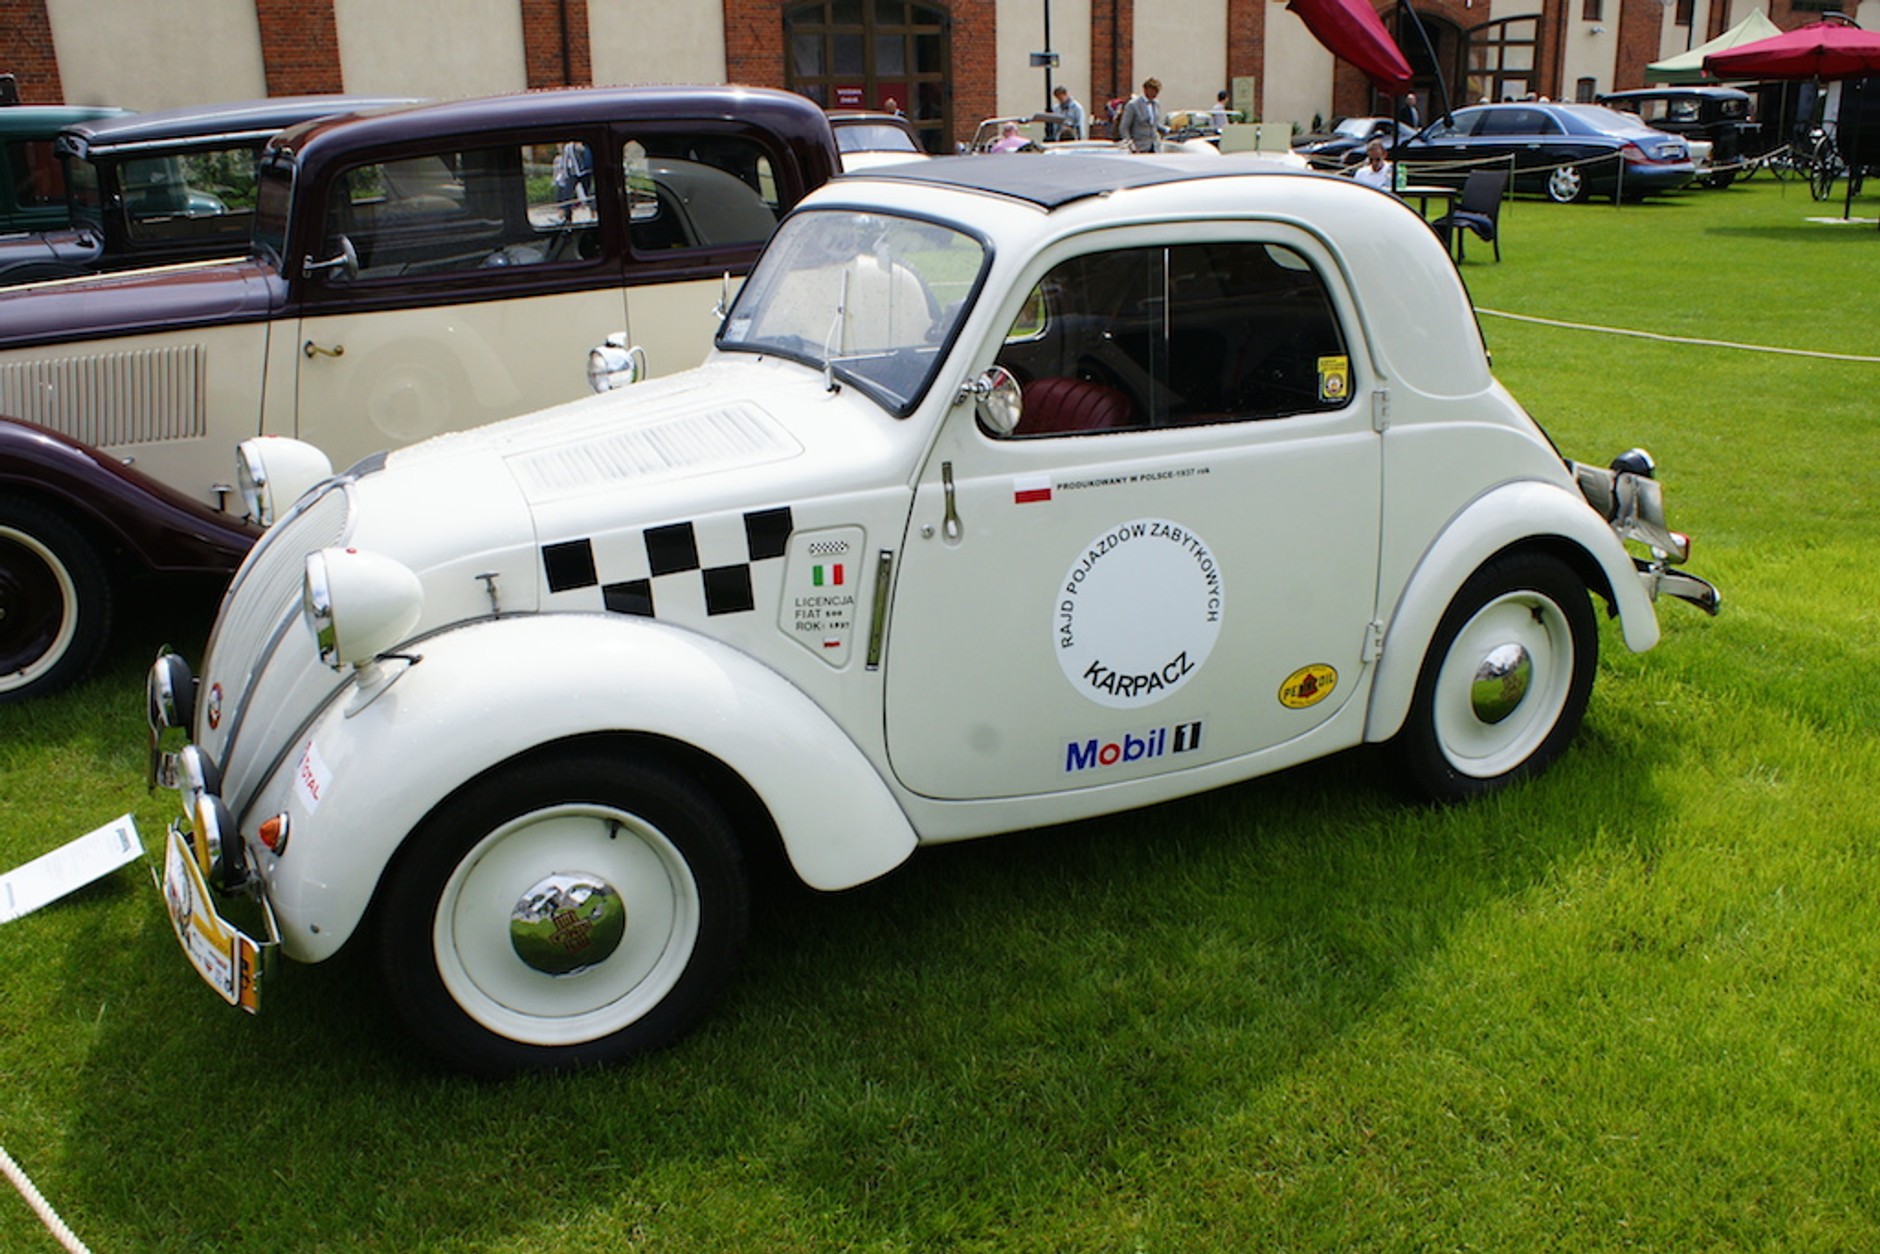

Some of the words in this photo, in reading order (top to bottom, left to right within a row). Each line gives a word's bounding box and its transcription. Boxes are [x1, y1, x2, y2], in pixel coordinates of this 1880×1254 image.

[1056, 476, 1128, 491] PRODUKOWANY
[1066, 523, 1147, 595] POJAZDÓW
[1149, 522, 1221, 623] ZABYTKOWYCH
[795, 595, 855, 607] LICENCJA
[795, 609, 821, 619] FIAT
[1060, 600, 1074, 649] RAJD
[1083, 651, 1195, 697] KARPACZ
[1065, 727, 1167, 773] Mobil
